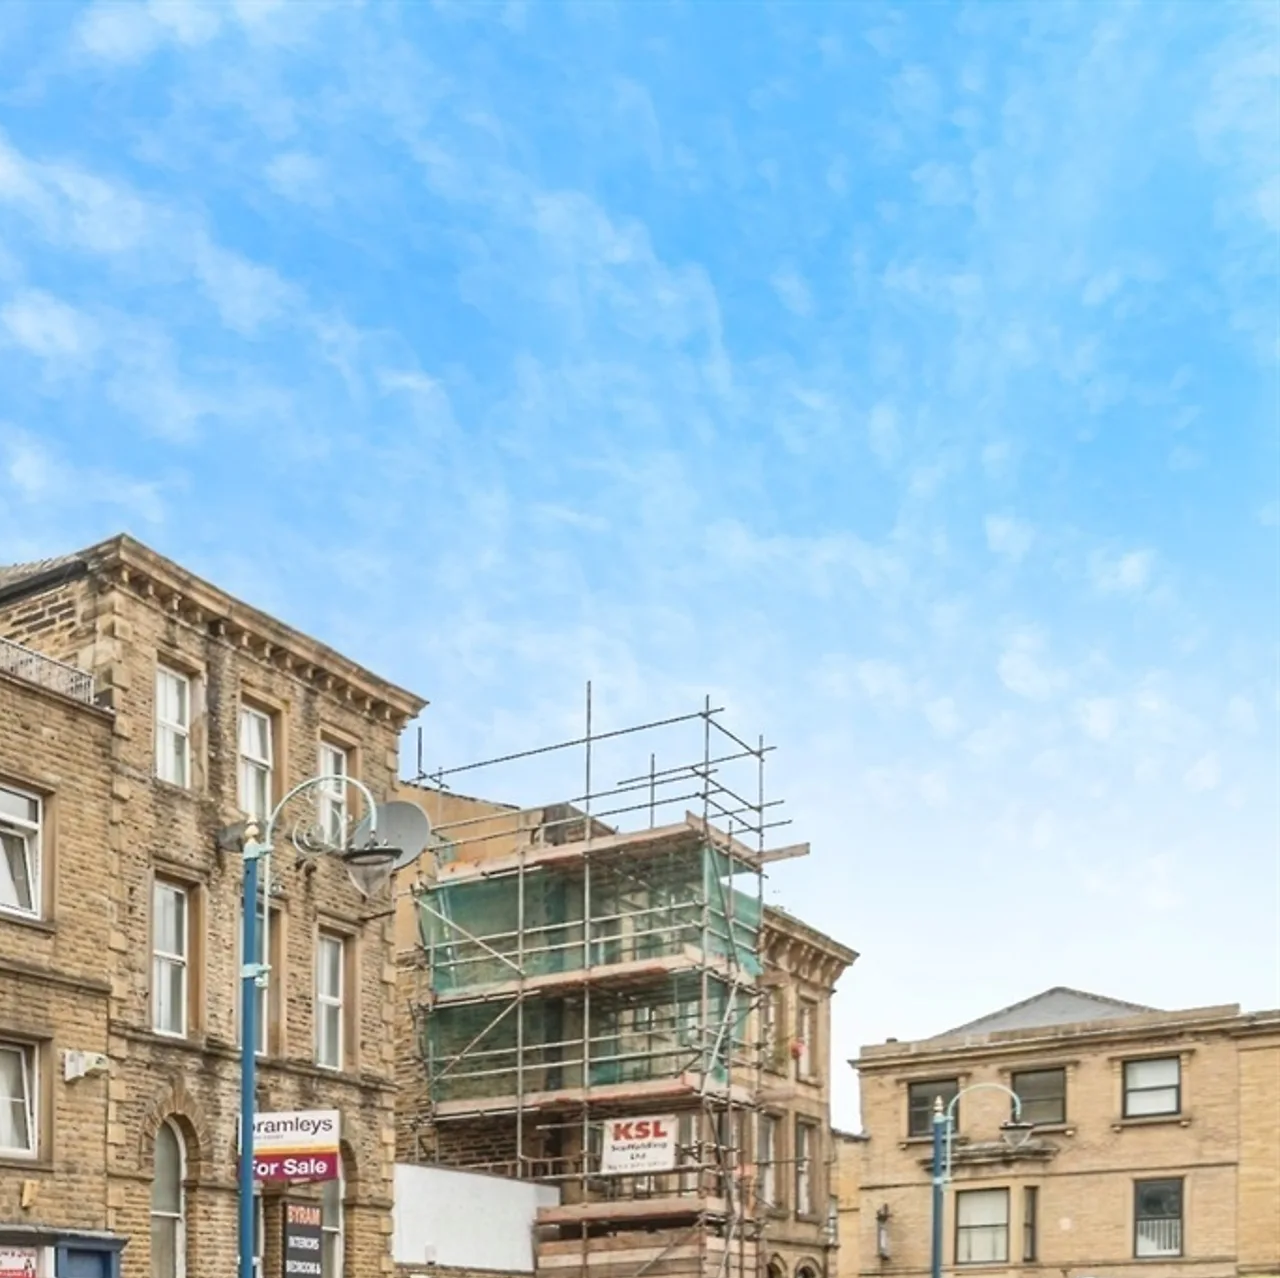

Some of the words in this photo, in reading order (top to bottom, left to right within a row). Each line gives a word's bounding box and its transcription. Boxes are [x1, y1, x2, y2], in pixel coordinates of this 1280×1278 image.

[252, 1116, 333, 1135] ramleys
[613, 1120, 668, 1141] KSL
[283, 1158, 328, 1175] Sale
[287, 1204, 320, 1225] BYRAM
